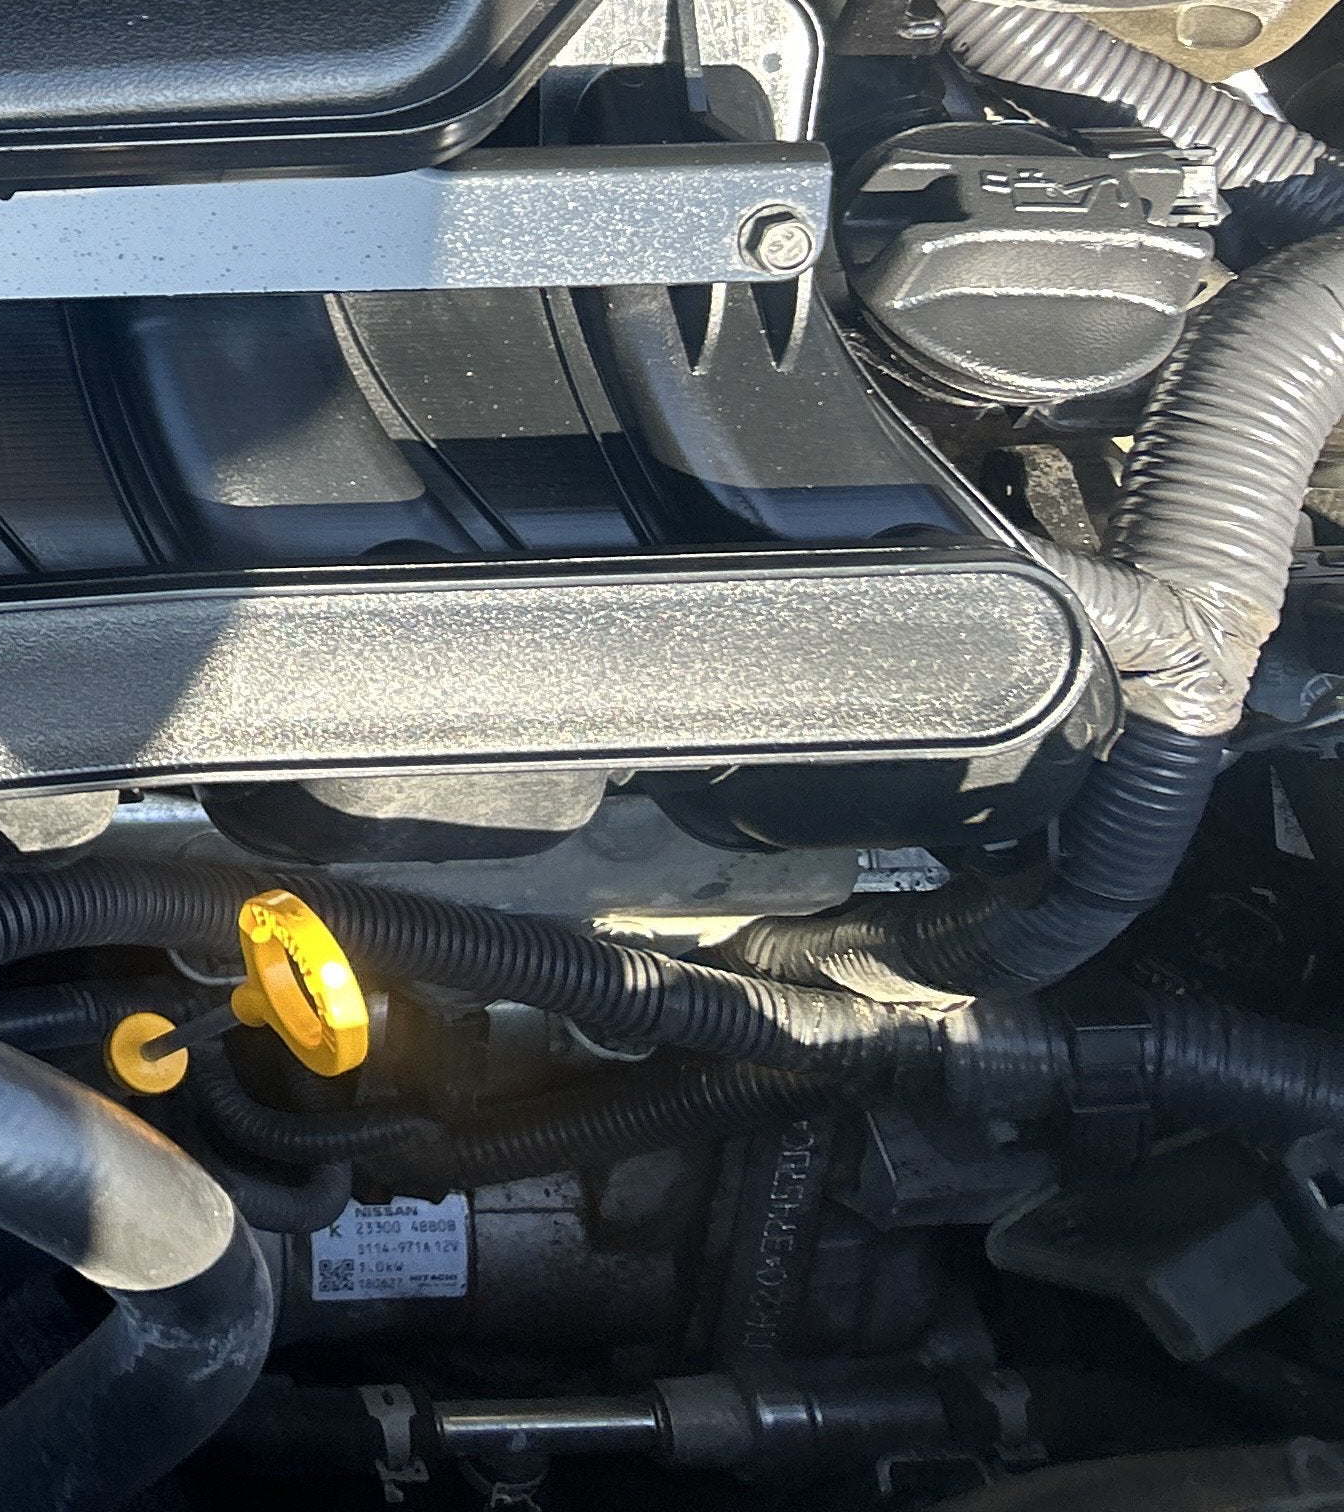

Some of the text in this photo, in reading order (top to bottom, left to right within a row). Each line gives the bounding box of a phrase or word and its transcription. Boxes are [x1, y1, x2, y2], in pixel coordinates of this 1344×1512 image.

[356, 1206, 419, 1218] NISSAN
[329, 1224, 343, 1238] K
[357, 1220, 401, 1235] 23300
[435, 1239, 459, 1253] 12V
